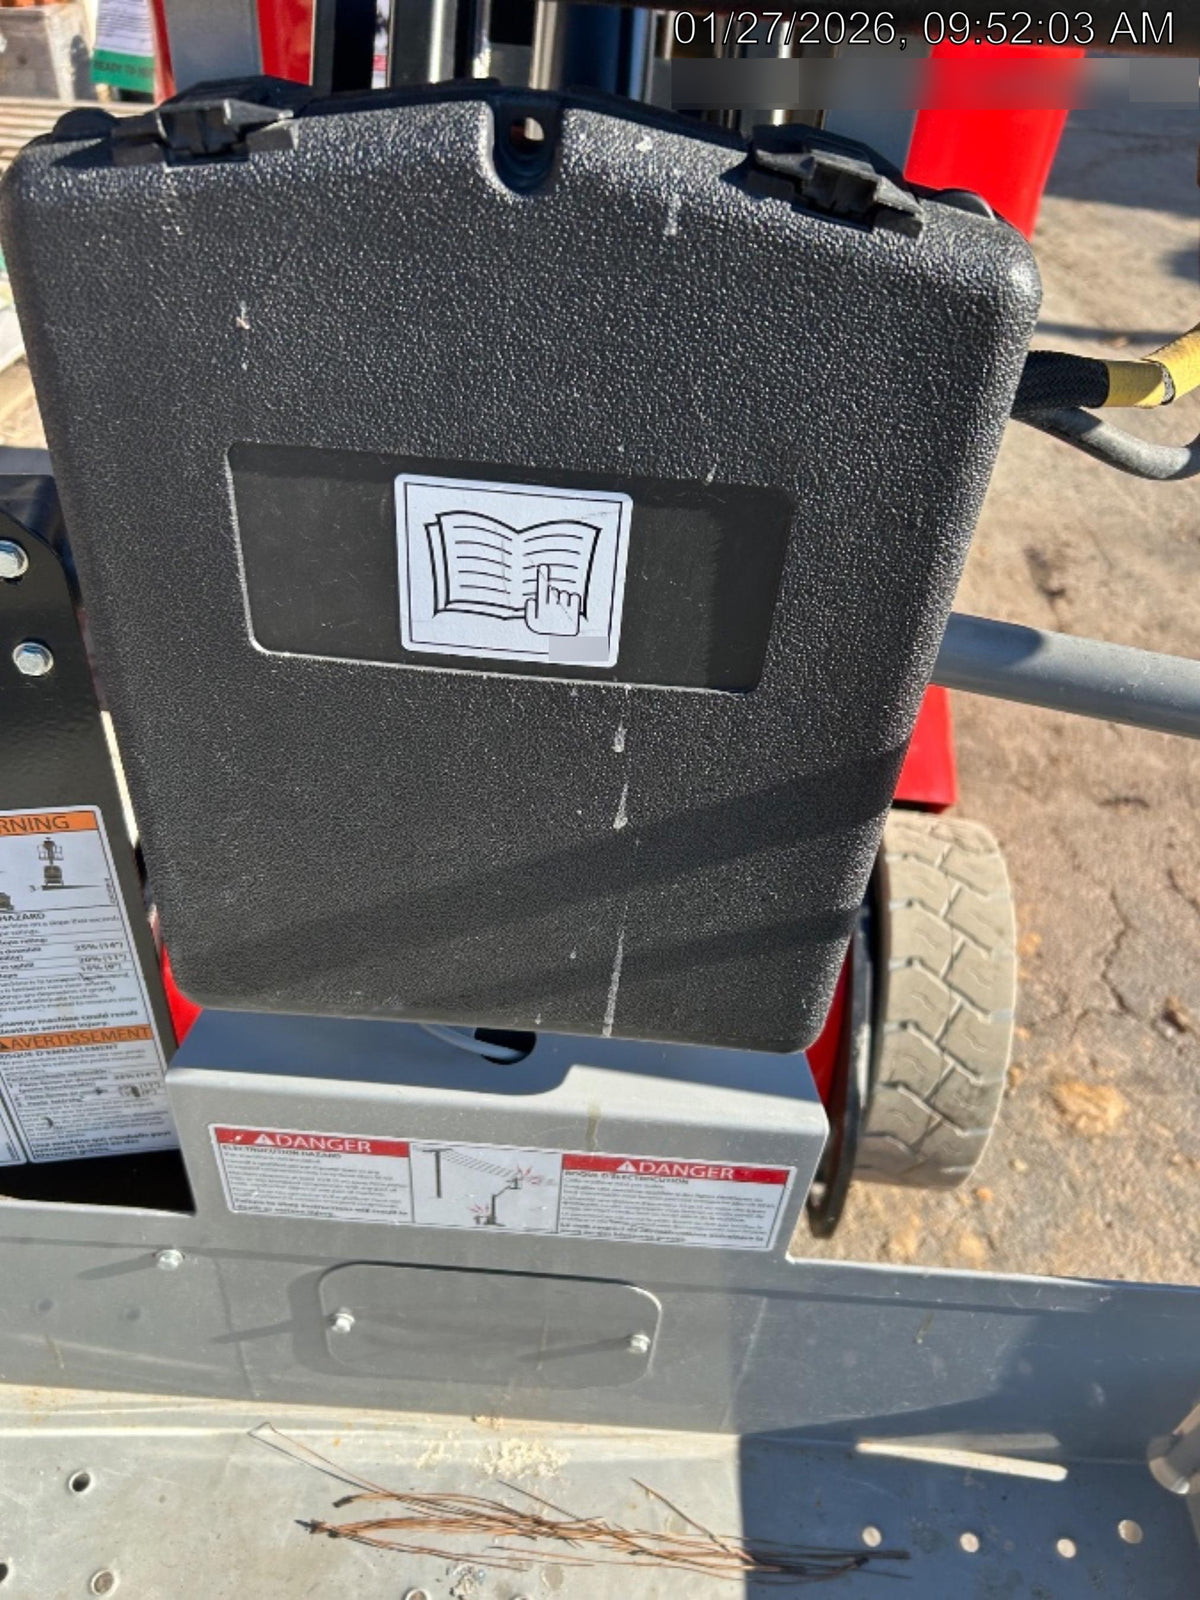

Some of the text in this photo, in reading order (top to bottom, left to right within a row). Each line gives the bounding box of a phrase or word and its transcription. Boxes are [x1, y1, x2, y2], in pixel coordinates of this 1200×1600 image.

[12, 1028, 150, 1050] AVERTISSEMENT
[275, 1134, 372, 1154] DANGER
[639, 1161, 735, 1181] DANGER
